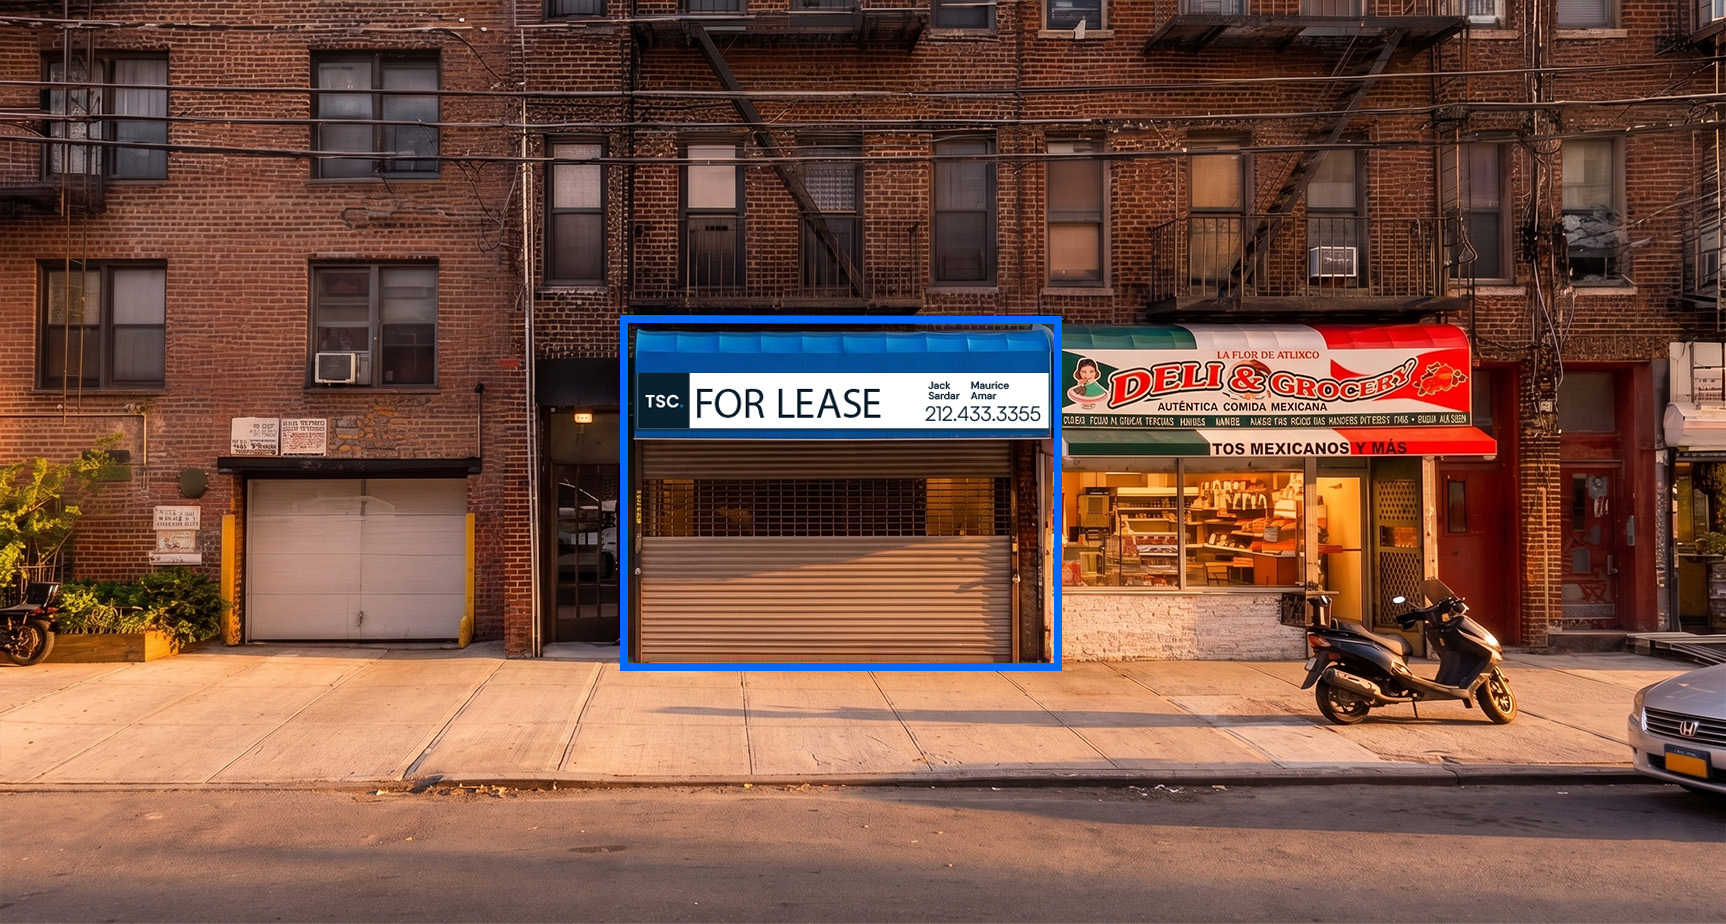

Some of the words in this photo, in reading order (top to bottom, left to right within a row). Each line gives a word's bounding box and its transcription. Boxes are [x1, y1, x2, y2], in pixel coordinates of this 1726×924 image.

[1216, 350, 1230, 359] LA
[1232, 350, 1258, 359] FLOR
[1260, 350, 1274, 359] DE
[1277, 350, 1320, 359] ATLIXCO
[927, 381, 951, 390] Jack
[970, 381, 1010, 390] Maurice
[1108, 361, 1225, 408] DELI
[1229, 364, 1266, 394] &
[1268, 357, 1417, 401] GROCERY
[928, 391, 960, 400] Sardar
[970, 391, 998, 400] Amar
[696, 388, 765, 419] FOR
[778, 388, 881, 419] LEASE
[1157, 400, 1219, 412] AUTÉNTICA
[1223, 402, 1267, 411] COMIDA
[1271, 402, 1328, 411] MEXICANA
[925, 405, 1042, 422] 212.433.3355
[1212, 442, 1246, 455] TOS
[1250, 442, 1350, 455] MEXICANOS
[1356, 442, 1366, 454] Y
[1371, 439, 1408, 454] MÁS
